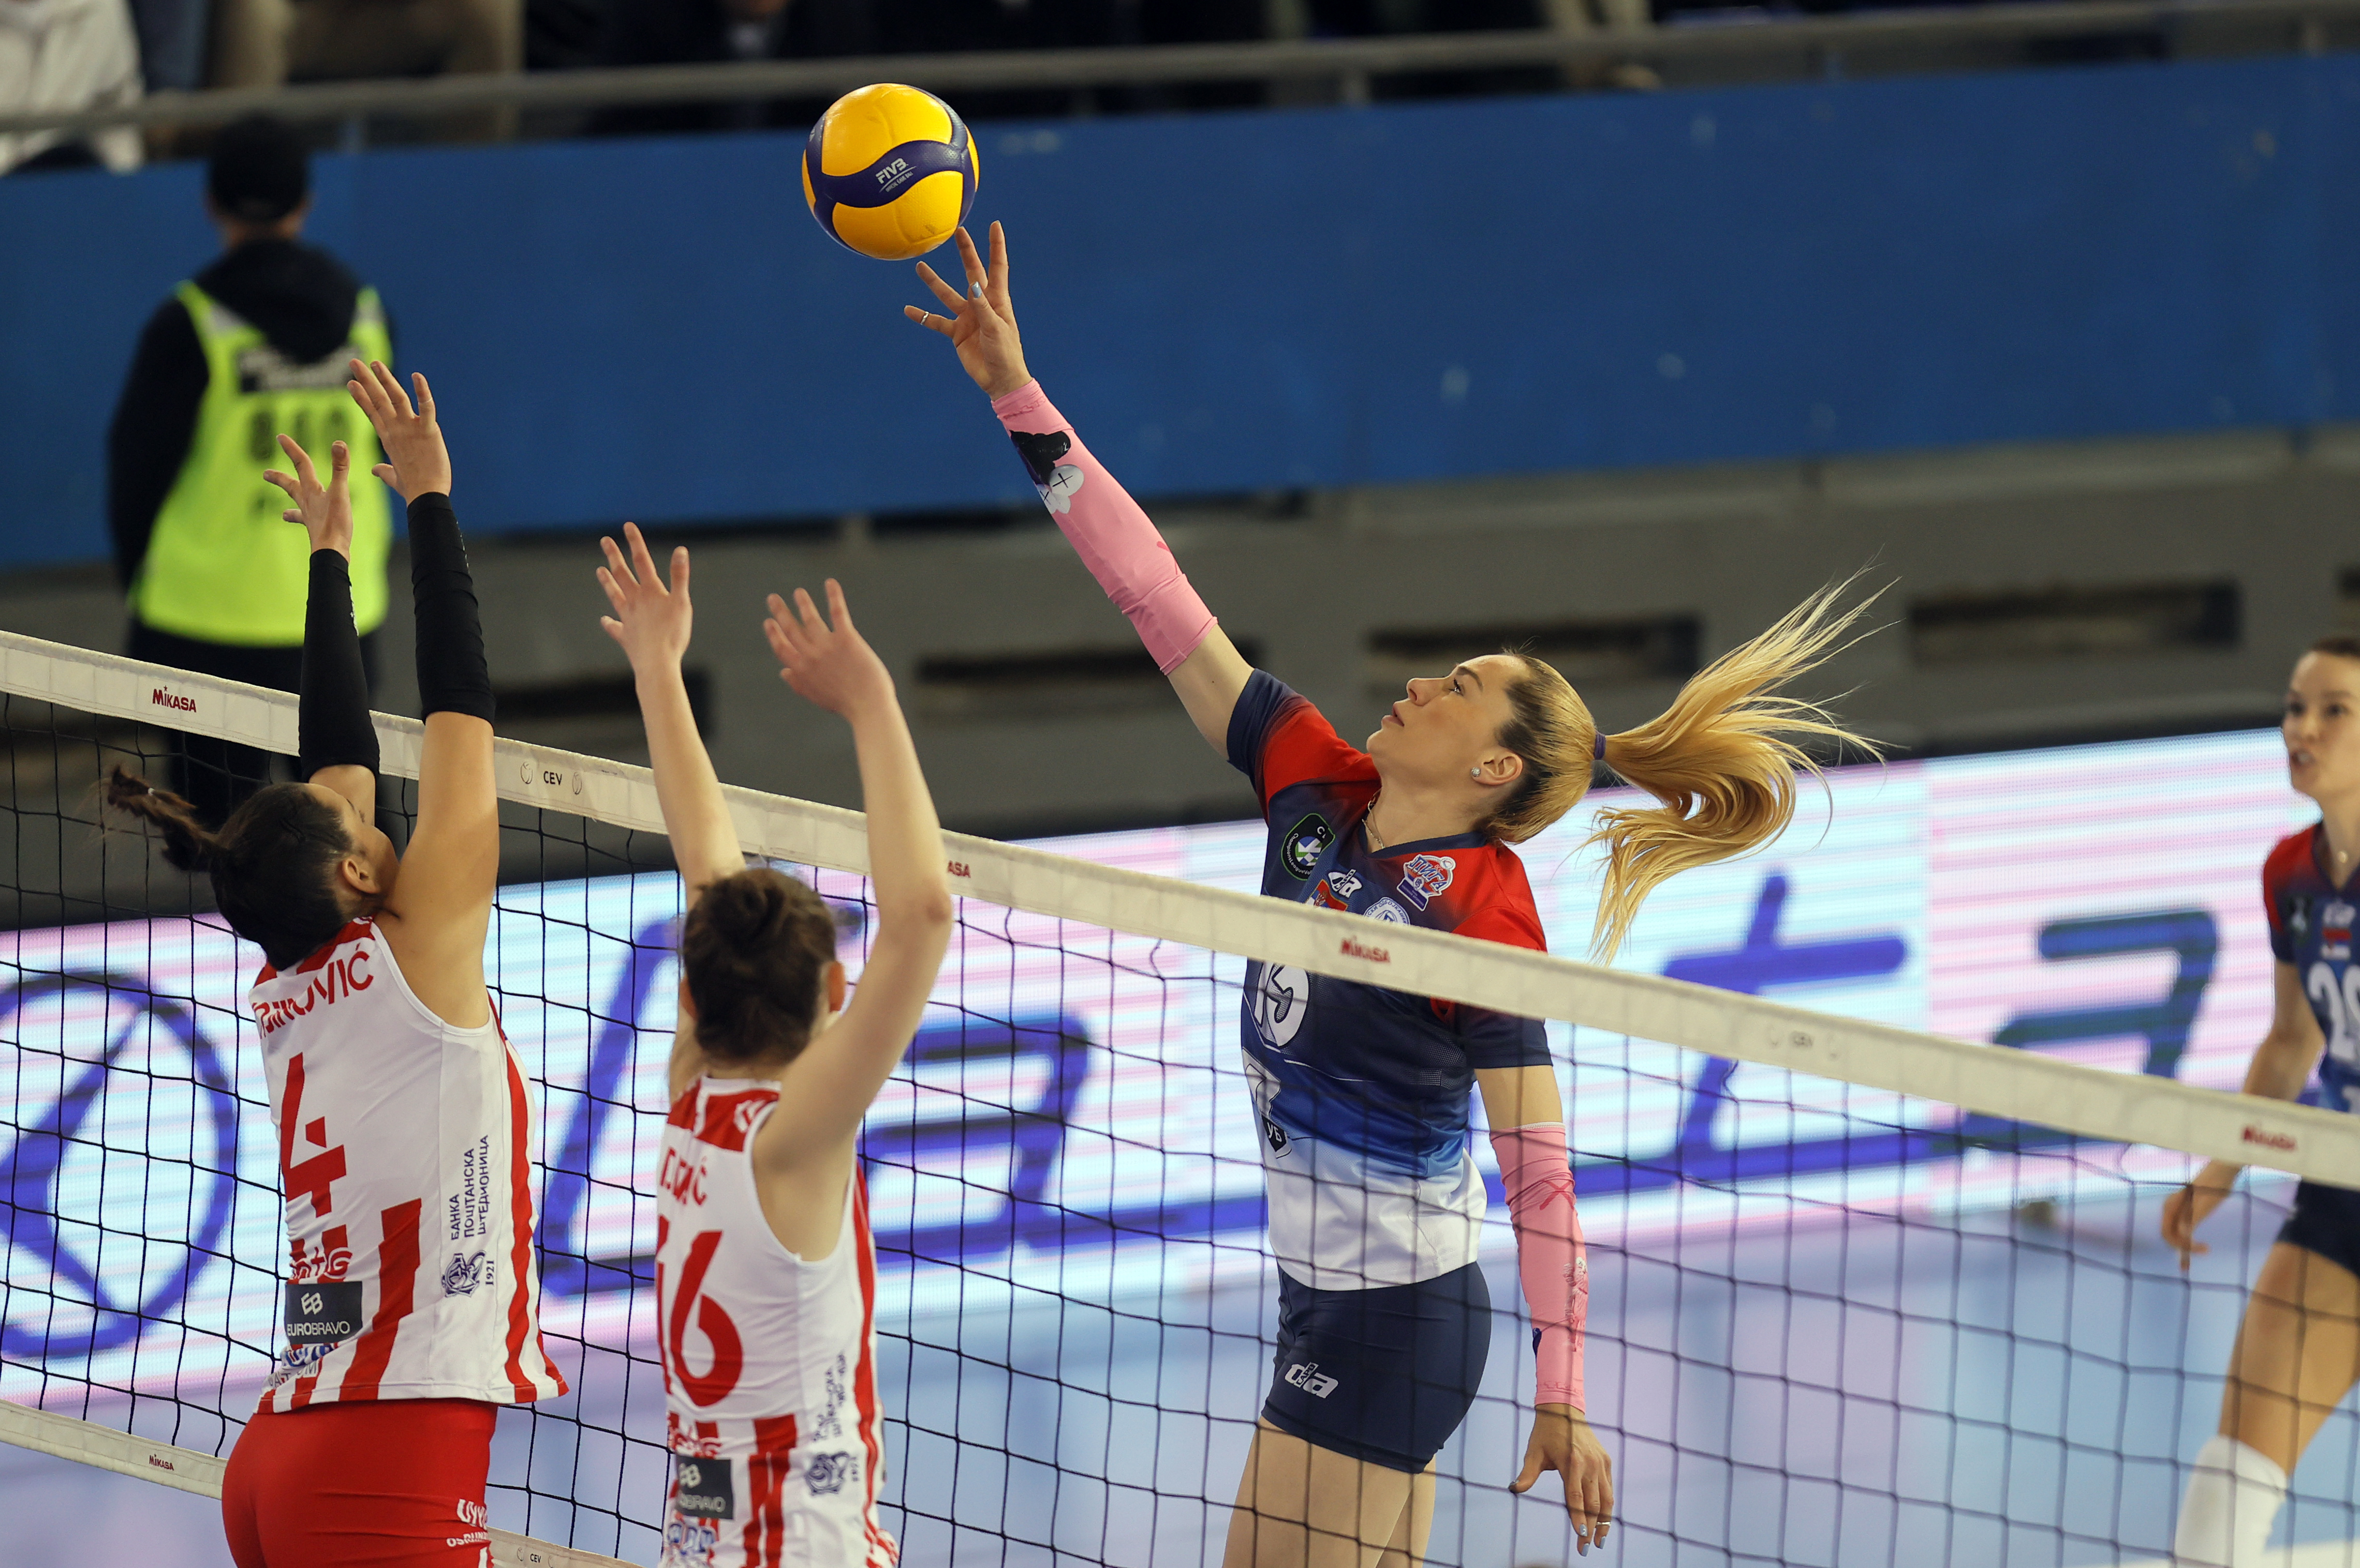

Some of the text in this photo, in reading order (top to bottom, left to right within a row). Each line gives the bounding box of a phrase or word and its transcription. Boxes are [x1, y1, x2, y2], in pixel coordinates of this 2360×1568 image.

[875, 158, 907, 184] FIVB
[543, 770, 563, 786] CEV
[947, 860, 971, 878] ASA
[1407, 855, 1448, 891] ЛИГА
[280, 1051, 347, 1218] 4
[464, 1148, 475, 1238] ПОШТАНСКА
[477, 1134, 490, 1235] ШТЕДИОНИЦА
[449, 1193, 460, 1240] БАНКА
[485, 1260, 495, 1286] 1921
[300, 1292, 323, 1315] EB
[287, 1321, 351, 1337] EUROBRAVO
[529, 1553, 541, 1563] CEV
